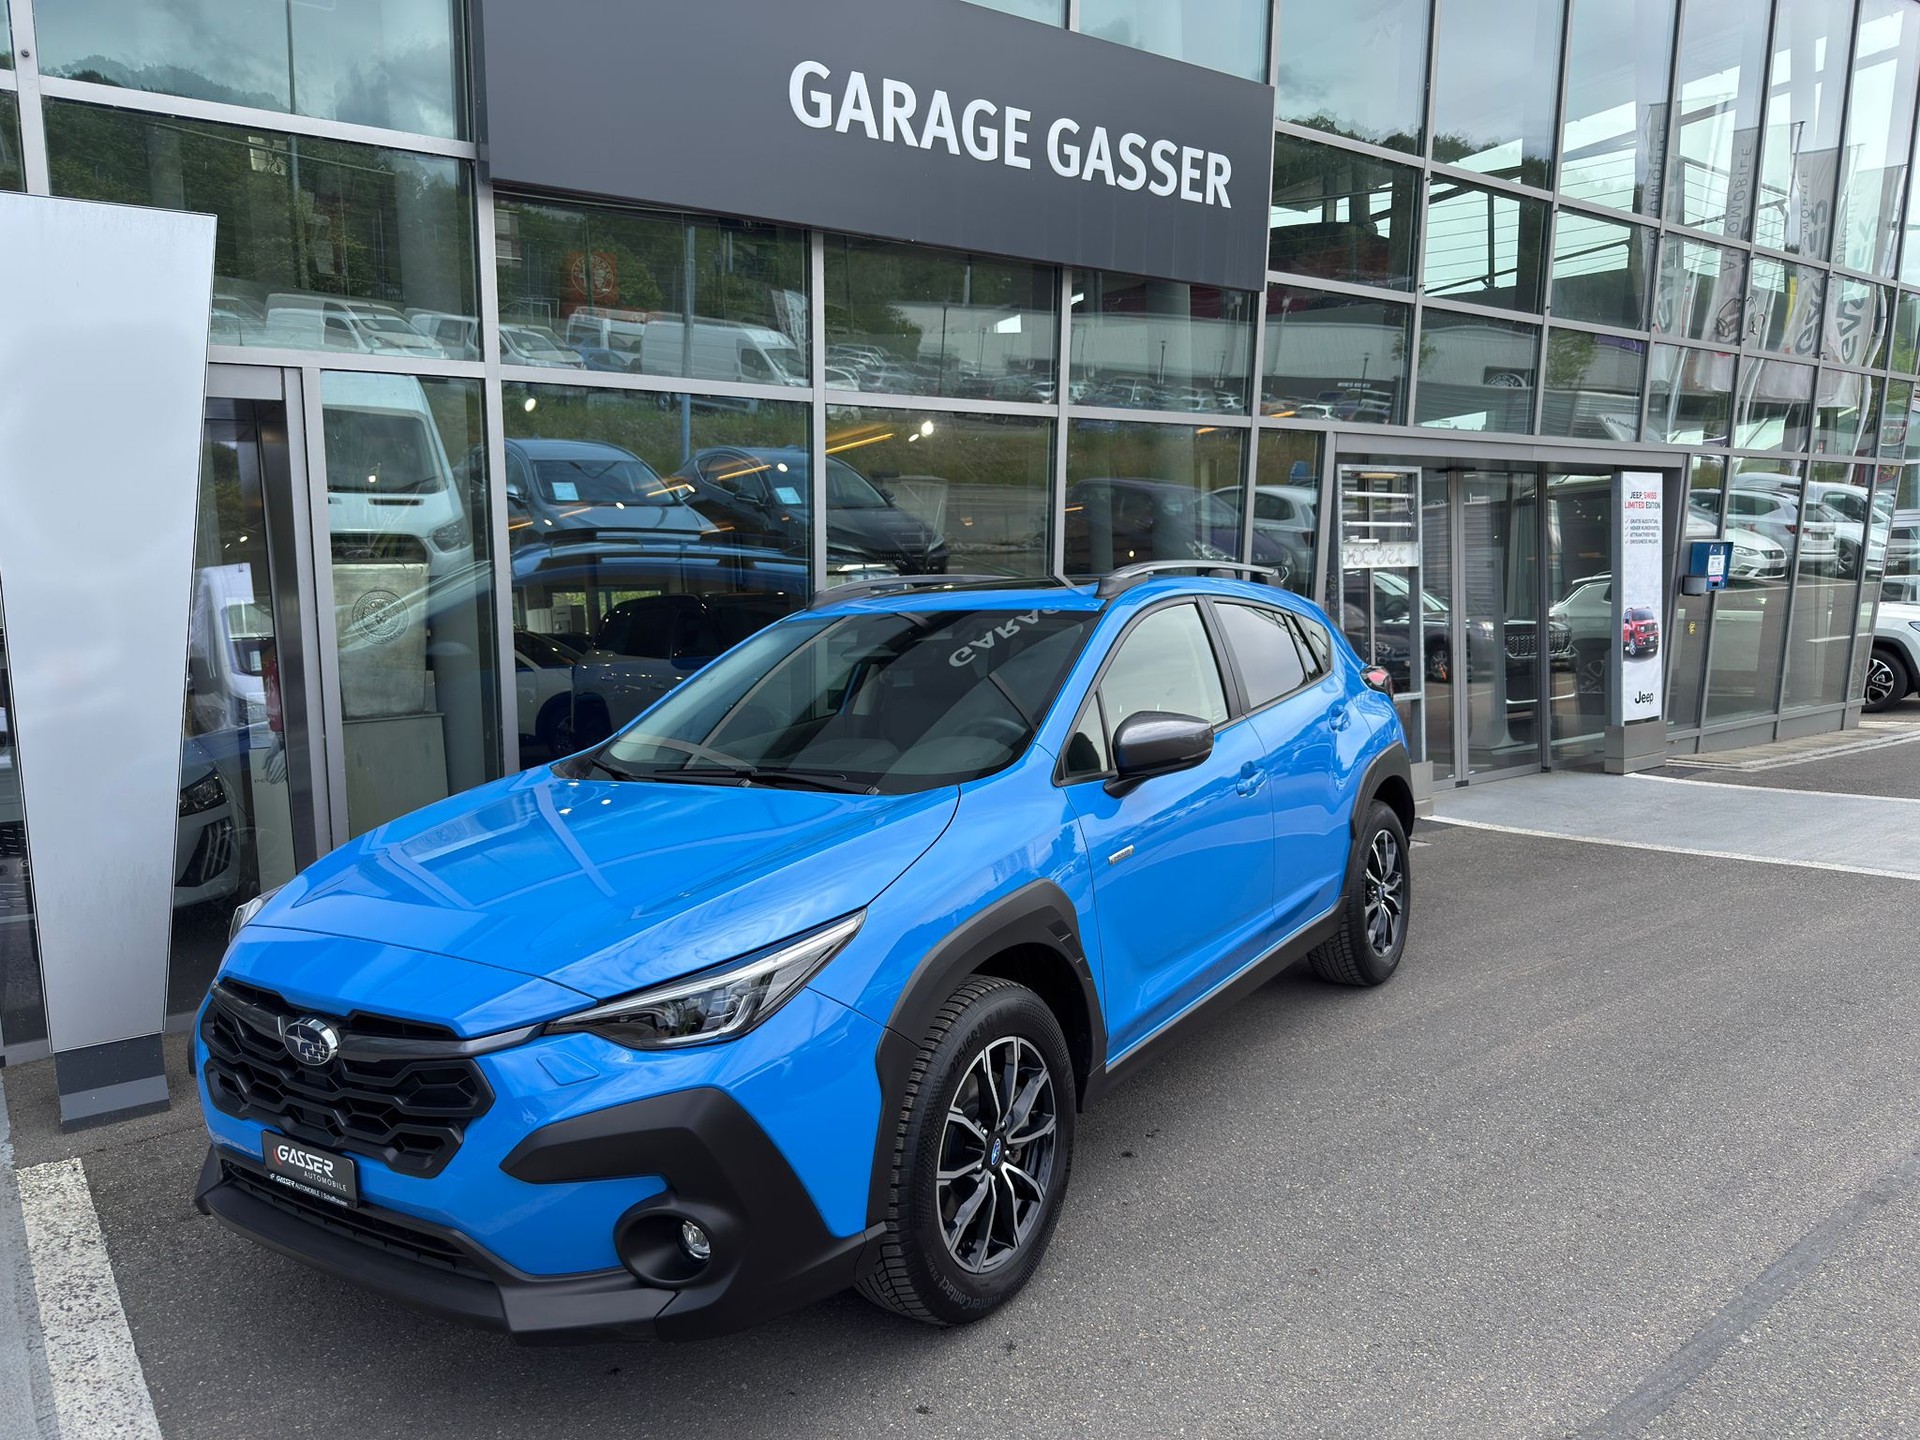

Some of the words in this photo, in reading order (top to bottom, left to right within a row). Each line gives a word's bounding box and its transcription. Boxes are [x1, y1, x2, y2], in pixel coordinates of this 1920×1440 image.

[789, 60, 1031, 170] GARAGE
[1047, 117, 1232, 209] GASSER
[1643, 491, 1657, 500] SWISS
[1624, 501, 1645, 509] LIMITED
[1635, 691, 1653, 704] Jeep
[277, 1145, 334, 1178] GASSER
[304, 1171, 347, 1192] AUTOMOBILE
